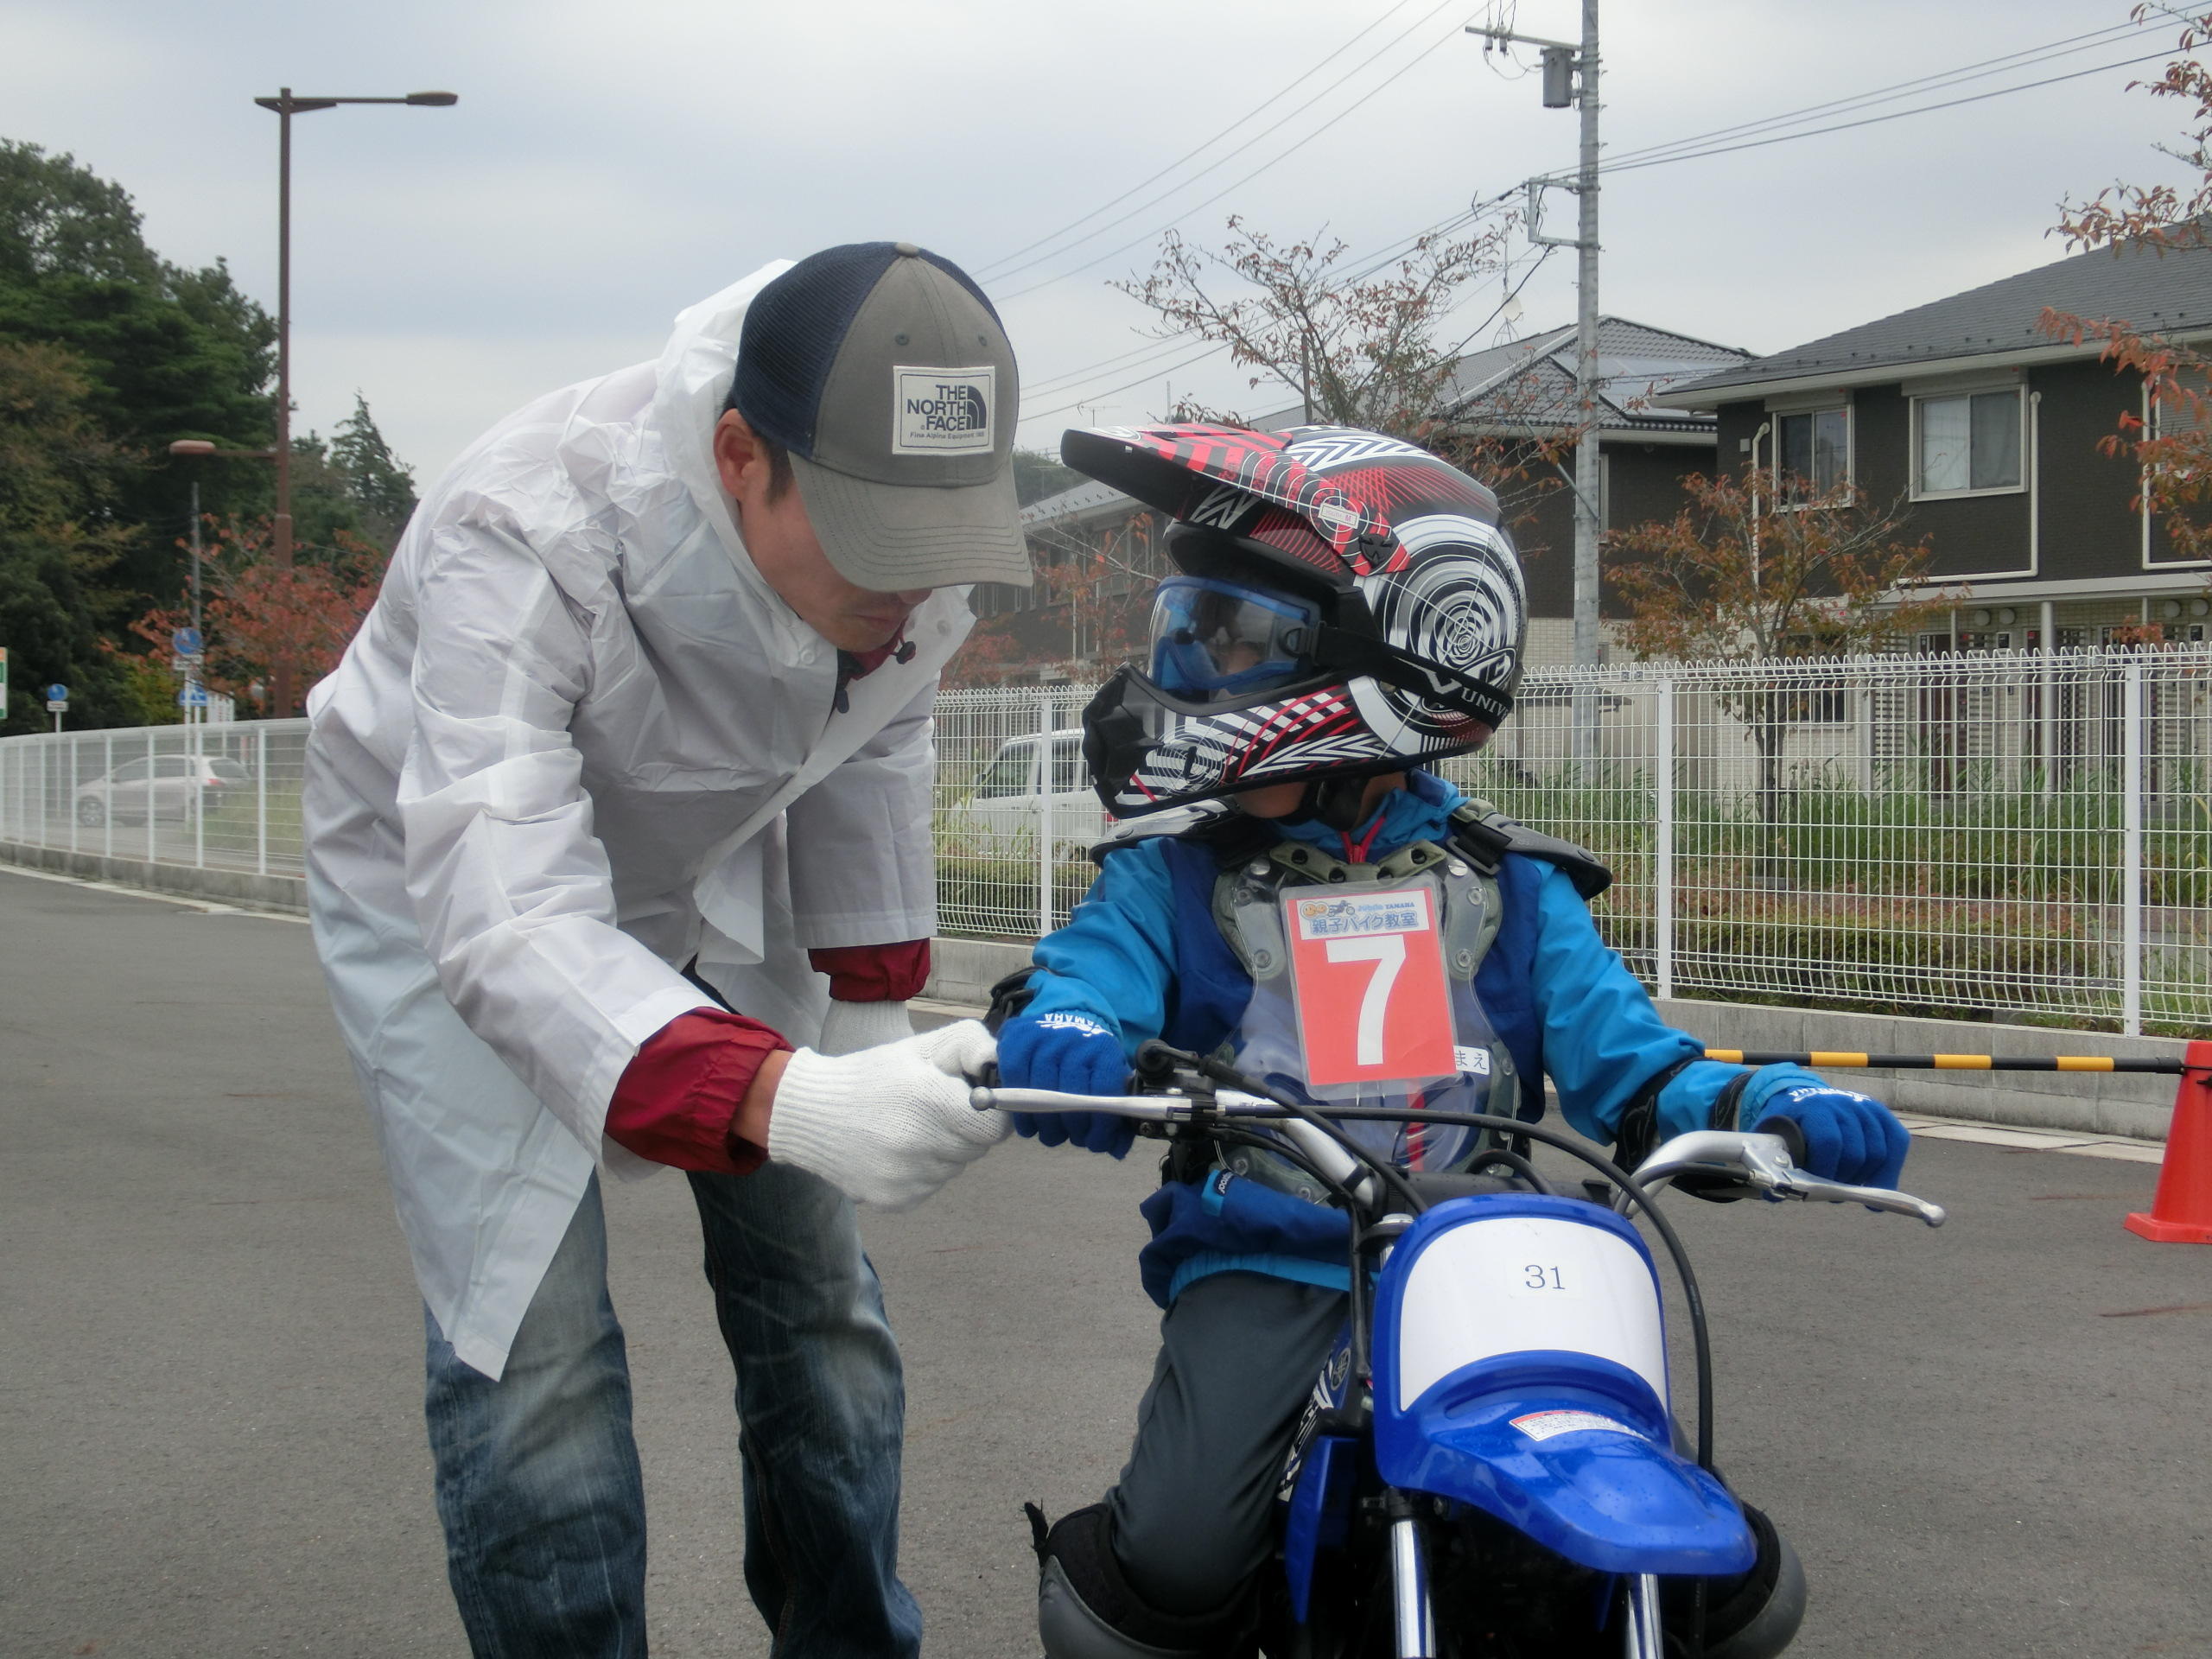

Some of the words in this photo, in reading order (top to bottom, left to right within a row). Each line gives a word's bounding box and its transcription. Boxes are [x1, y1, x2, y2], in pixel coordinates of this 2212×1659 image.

[935, 385, 966, 400] THE
[907, 399, 966, 415] NORTH
[926, 416, 966, 431] FACE
[1311, 912, 1417, 935] 親子バイク教室
[1325, 934, 1407, 1065] 7
[1524, 1264, 1566, 1290] 31
